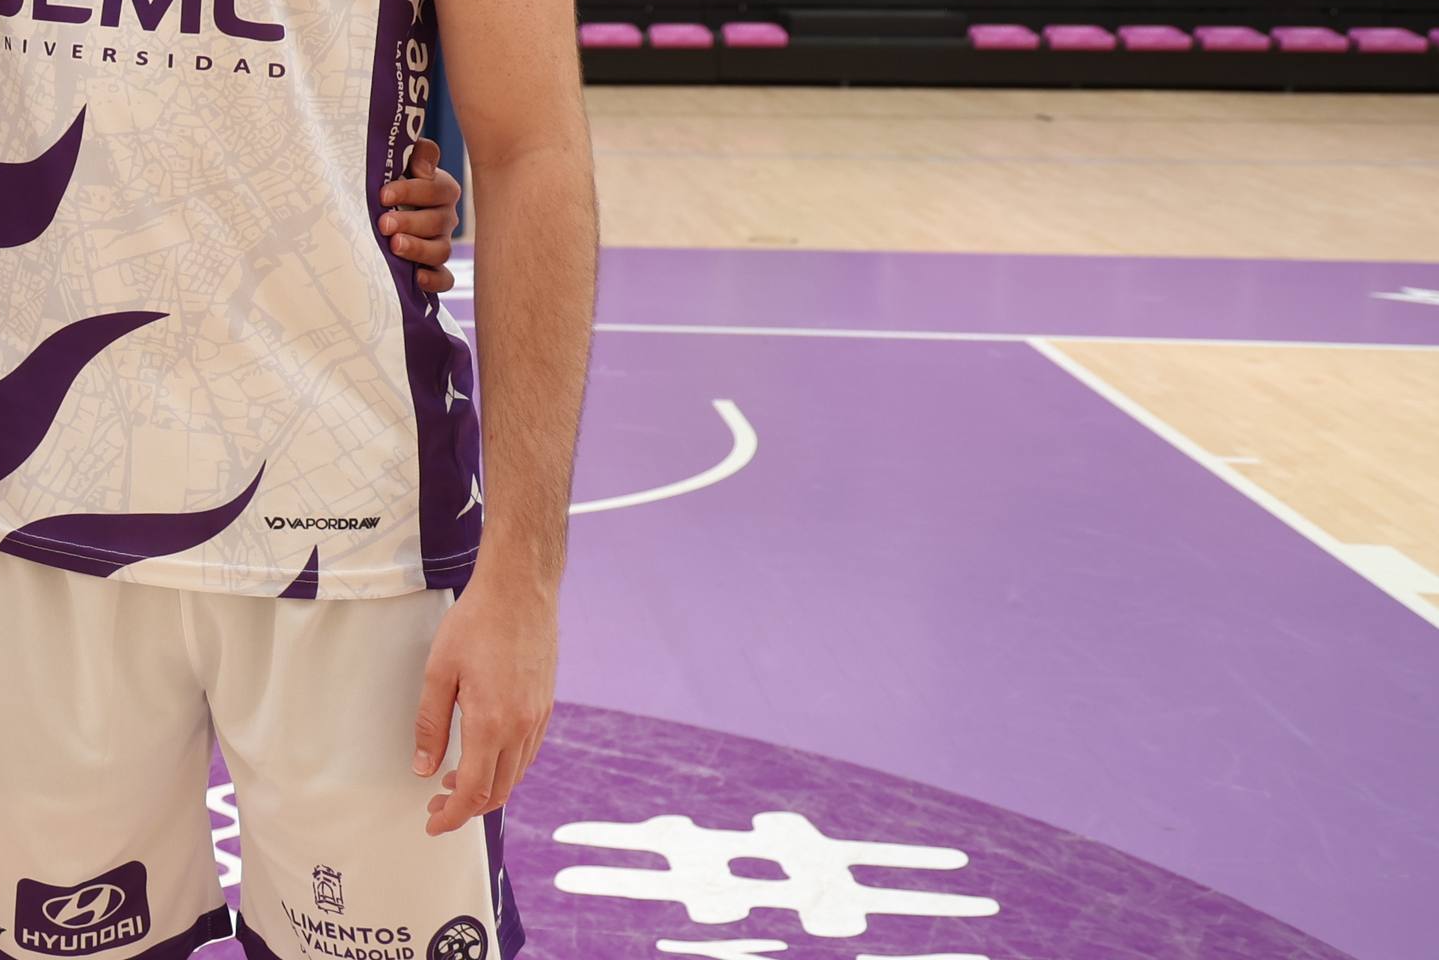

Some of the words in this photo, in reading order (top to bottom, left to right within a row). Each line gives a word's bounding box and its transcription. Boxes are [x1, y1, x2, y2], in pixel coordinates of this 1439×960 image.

[396, 40, 403, 59] LA
[388, 62, 404, 146] FORMACIÓN
[385, 148, 394, 168] DE
[286, 516, 381, 530] VAPORDRAW
[22, 915, 144, 951] HYUNDAI
[301, 928, 415, 960] VALLADOLID
